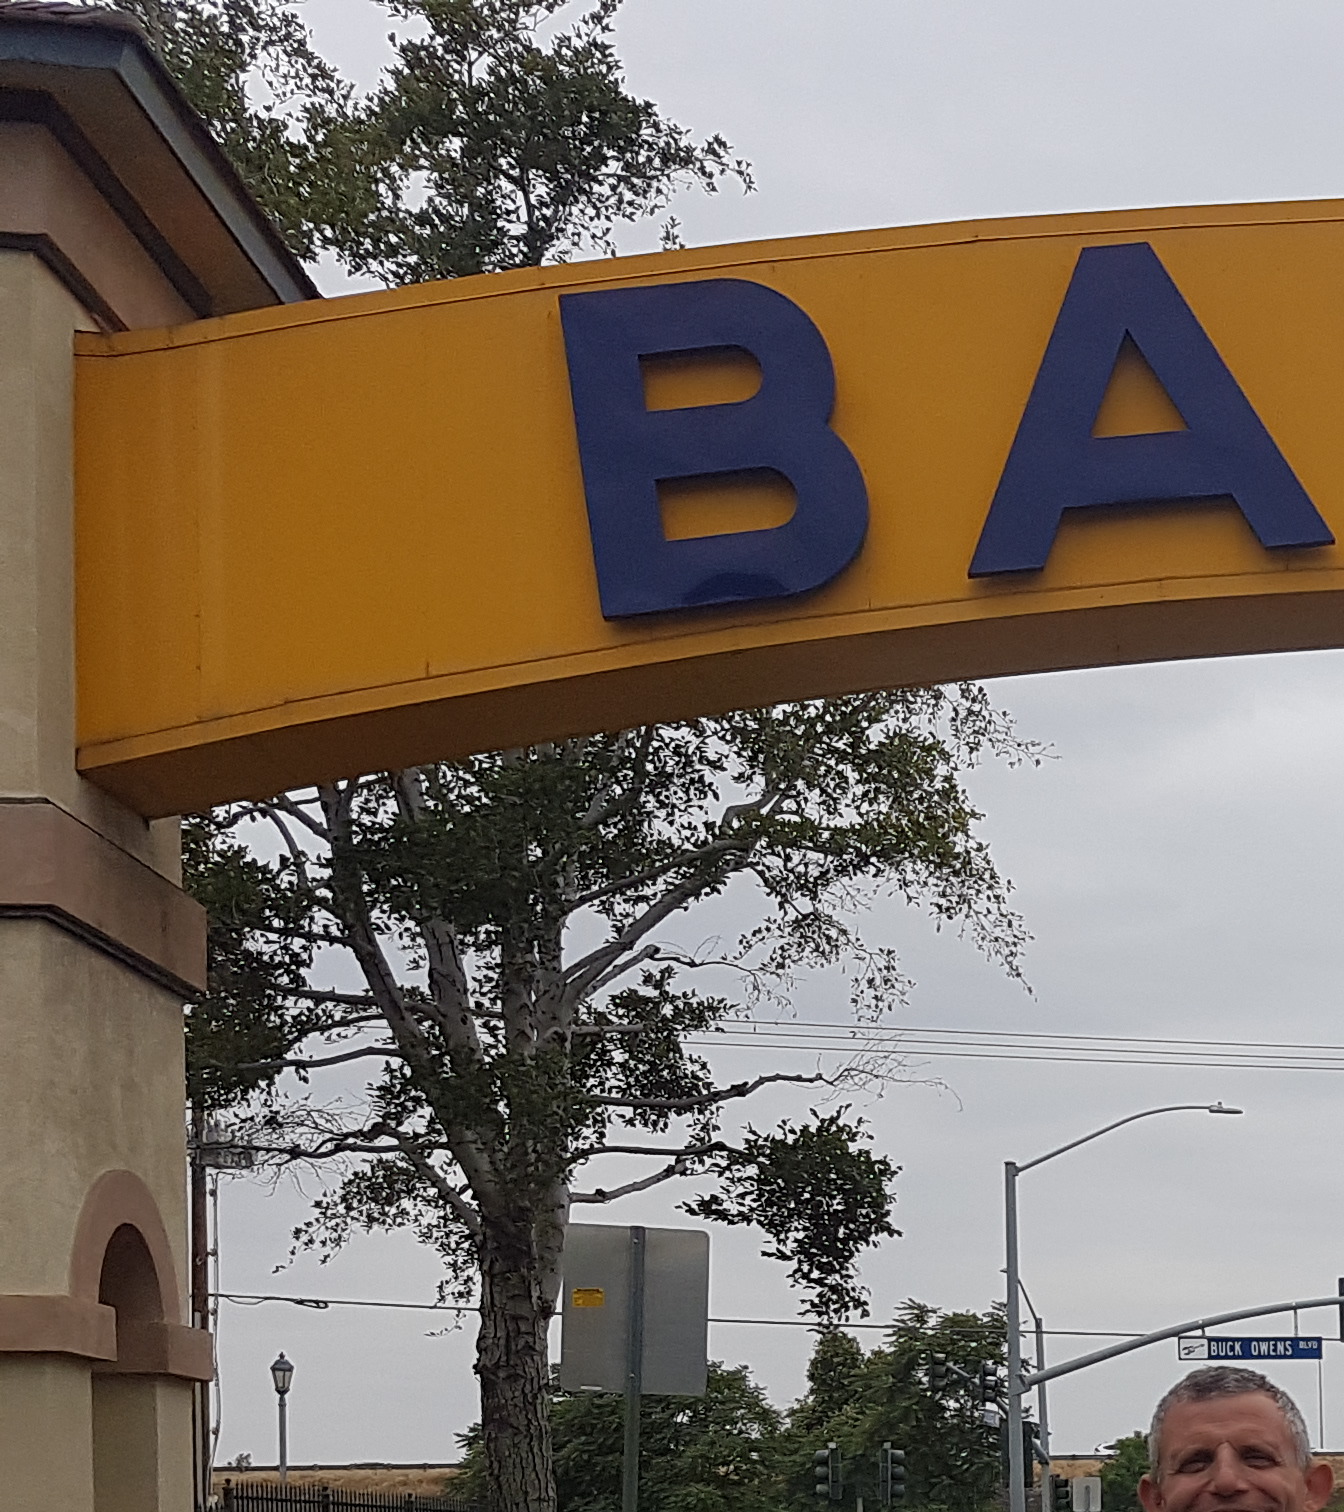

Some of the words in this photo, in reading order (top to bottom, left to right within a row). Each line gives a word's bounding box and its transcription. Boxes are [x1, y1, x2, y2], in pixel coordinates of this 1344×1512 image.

[1210, 1341, 1242, 1356] BUCK
[1251, 1341, 1293, 1356] OWENS
[1299, 1341, 1318, 1349] BLVD
